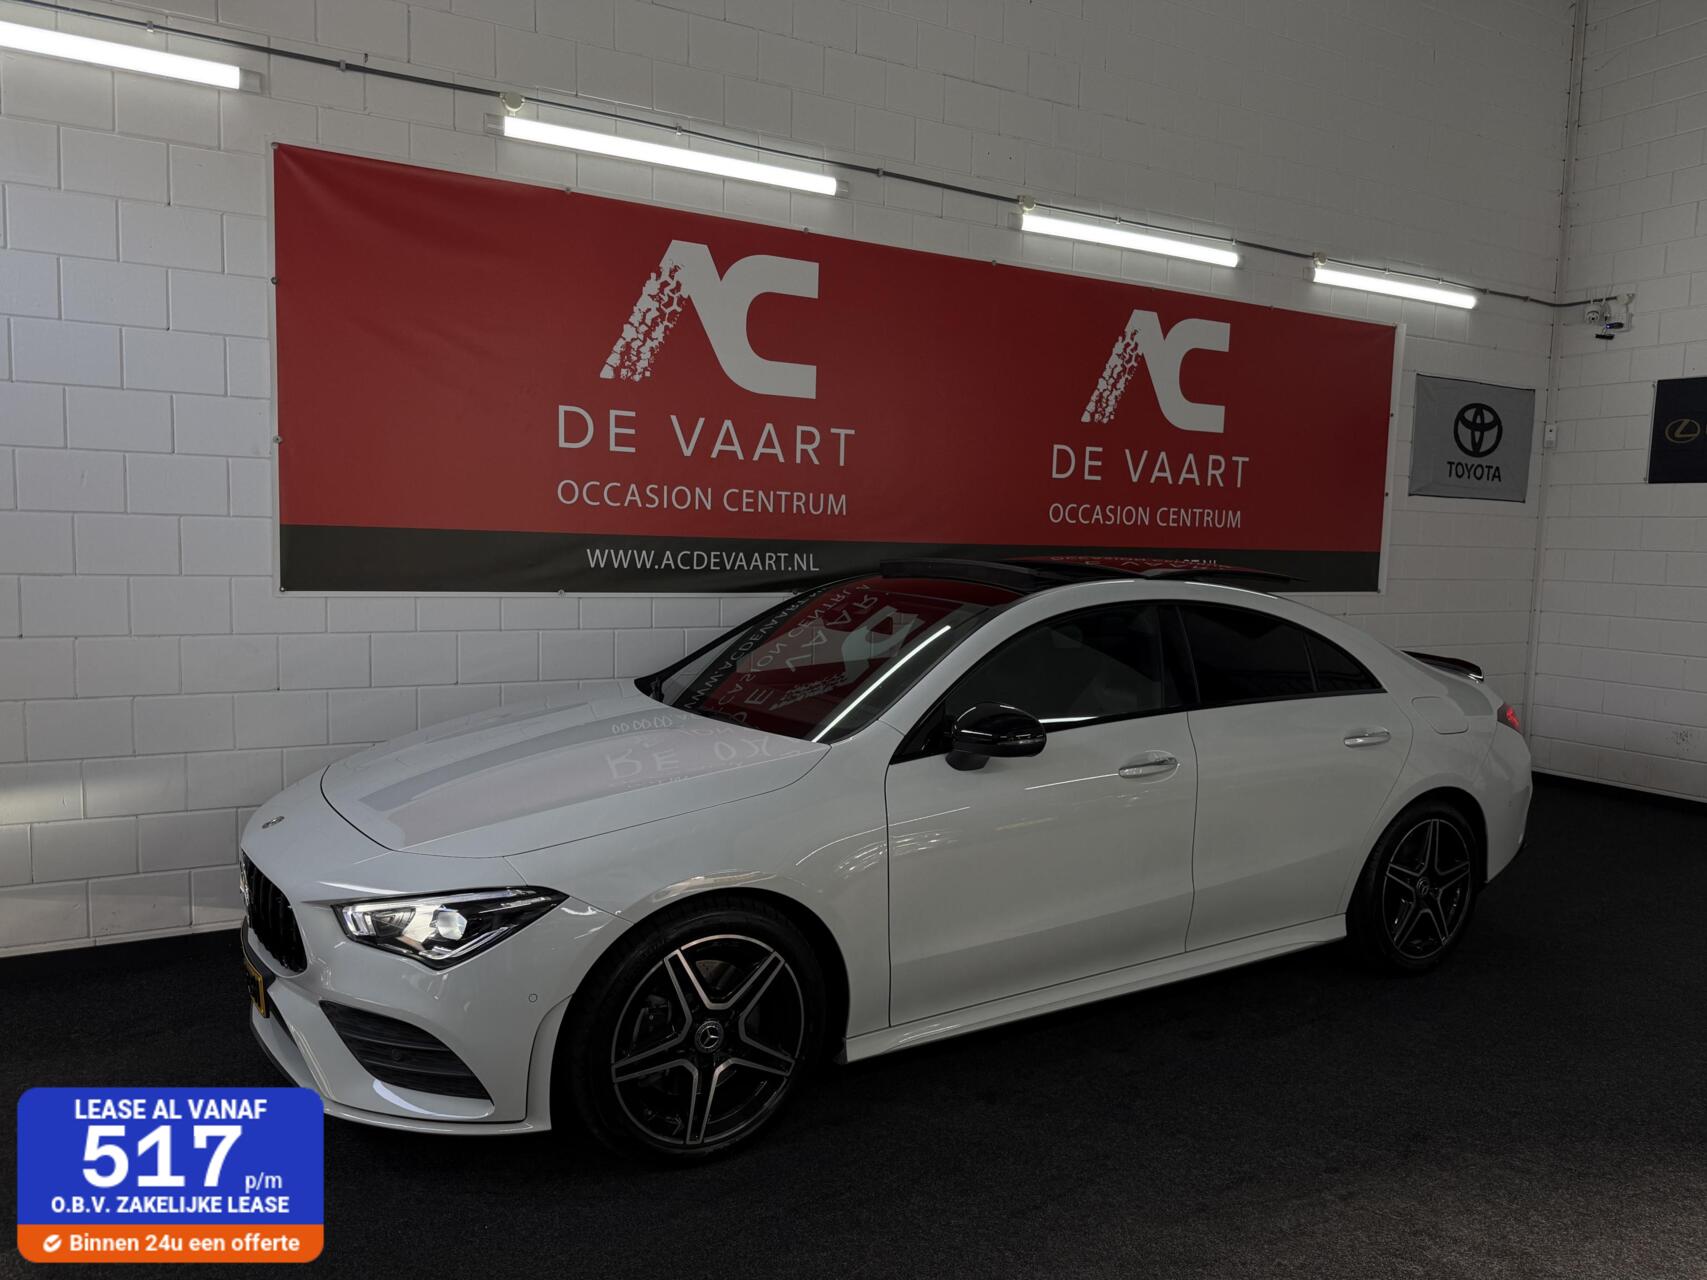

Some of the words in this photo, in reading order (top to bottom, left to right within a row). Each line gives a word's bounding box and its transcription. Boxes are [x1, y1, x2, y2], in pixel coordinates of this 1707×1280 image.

[600, 240, 819, 400] AC
[1081, 309, 1231, 434] AC
[558, 404, 636, 453] DE
[670, 414, 855, 467] VAART
[1051, 444, 1103, 481] DE
[1124, 448, 1250, 488] VAART
[1446, 460, 1502, 482] TOYOTA
[557, 479, 712, 510] OCCASION
[723, 488, 846, 516] CENTRUM
[1049, 502, 1150, 526] OCCASION
[1156, 507, 1241, 529] CENTRUM
[586, 548, 820, 571] WWW.ACDEVAART.NL
